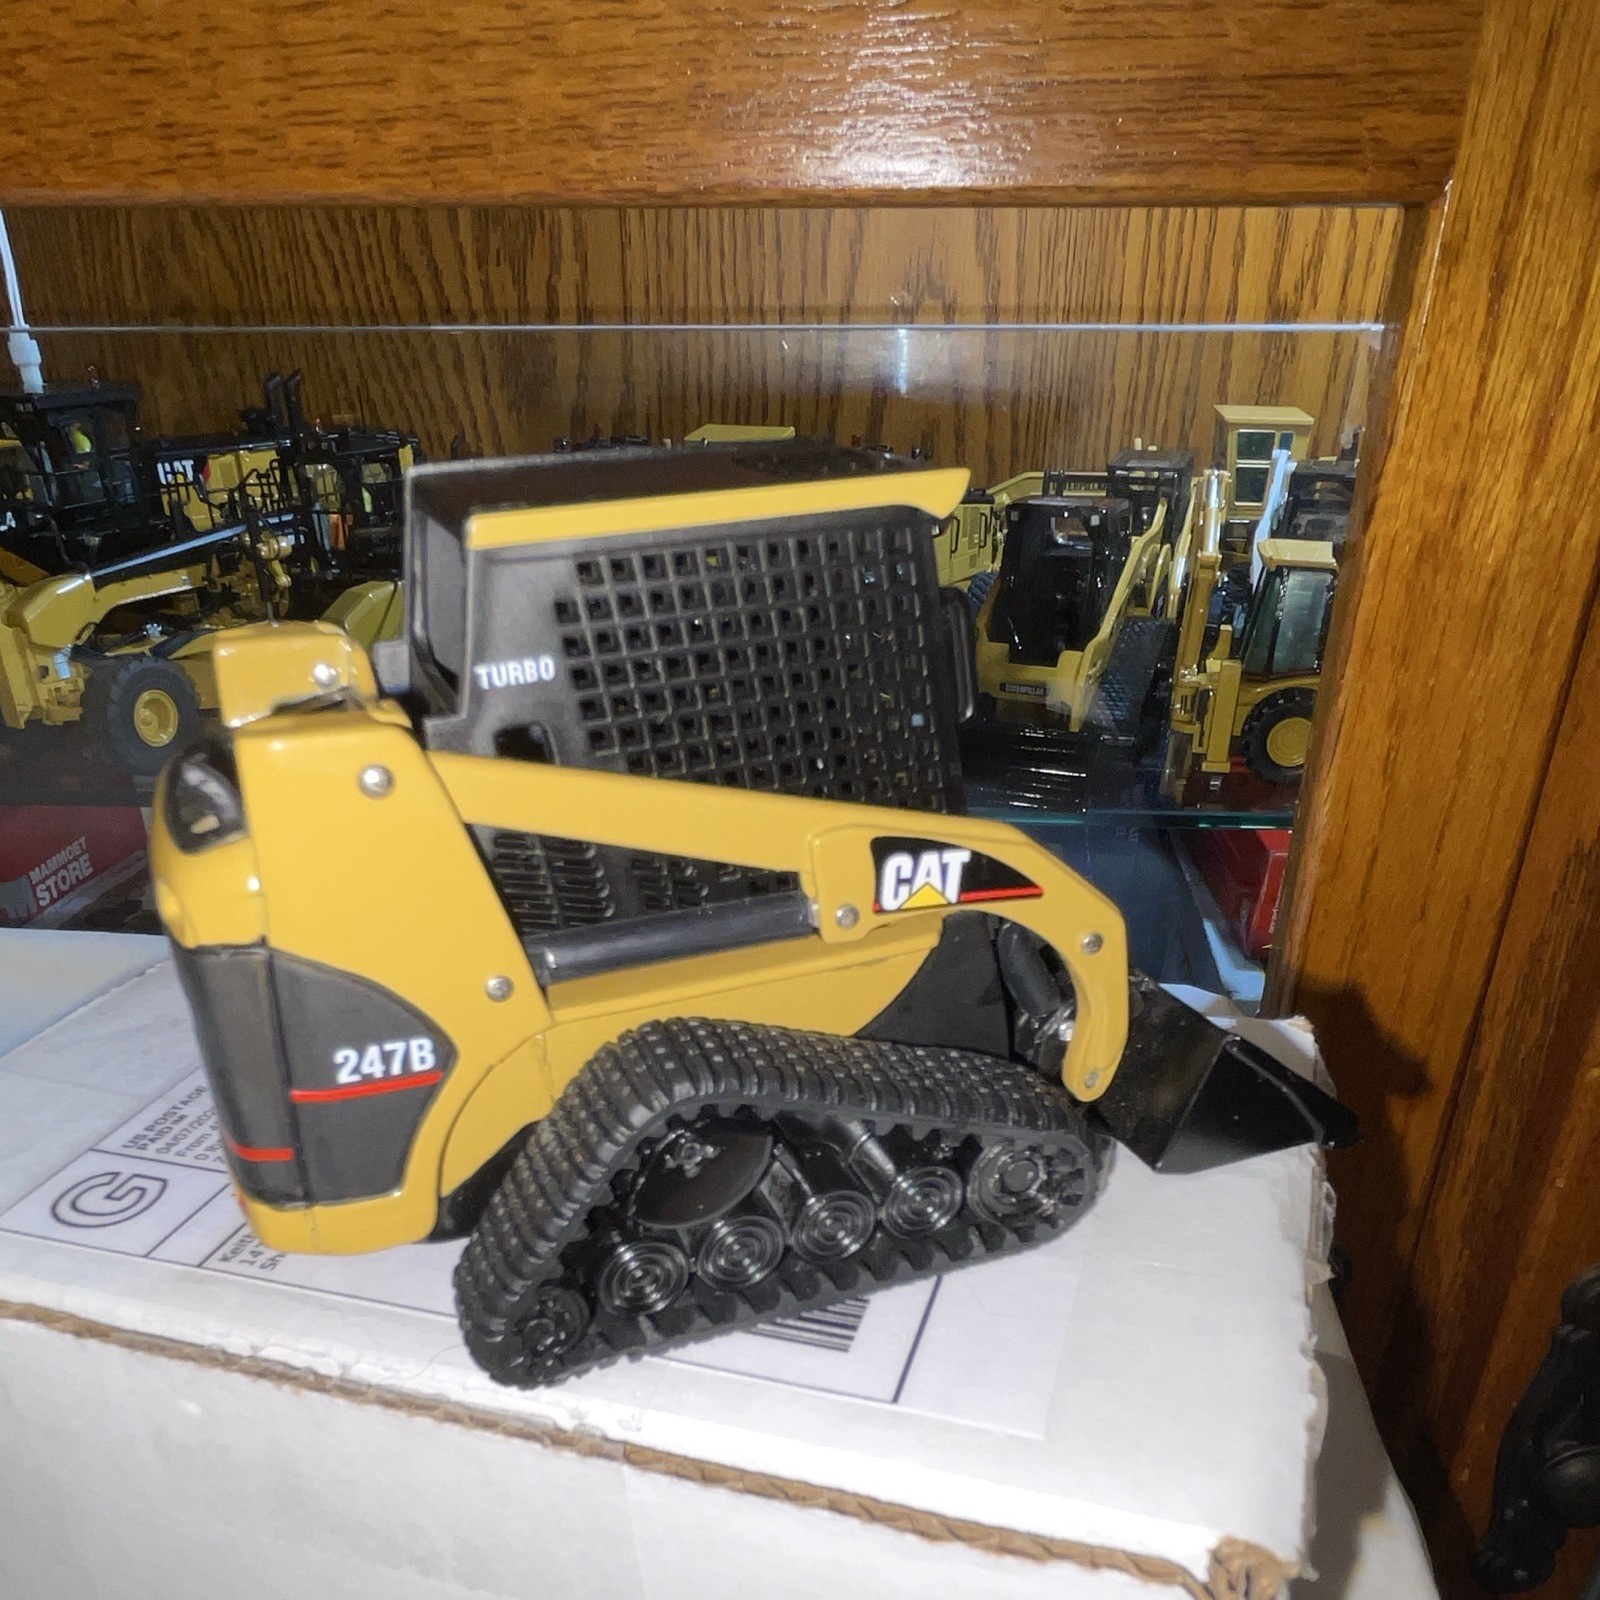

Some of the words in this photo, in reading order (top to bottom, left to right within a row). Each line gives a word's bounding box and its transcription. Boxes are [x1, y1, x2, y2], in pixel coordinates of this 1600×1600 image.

[157, 459, 194, 485] CAT
[473, 654, 556, 690] TURBO
[29, 835, 87, 884] MAMMOET
[35, 853, 94, 907] STORE
[880, 848, 972, 911] CAT
[333, 1037, 437, 1085] 247B
[121, 1133, 149, 1149] US
[143, 1085, 208, 1132] POSTAGE
[136, 1126, 174, 1151] PAID
[155, 1106, 218, 1155] 04/07/202
[51, 1171, 170, 1228] G
[259, 1253, 287, 1271] Sh
